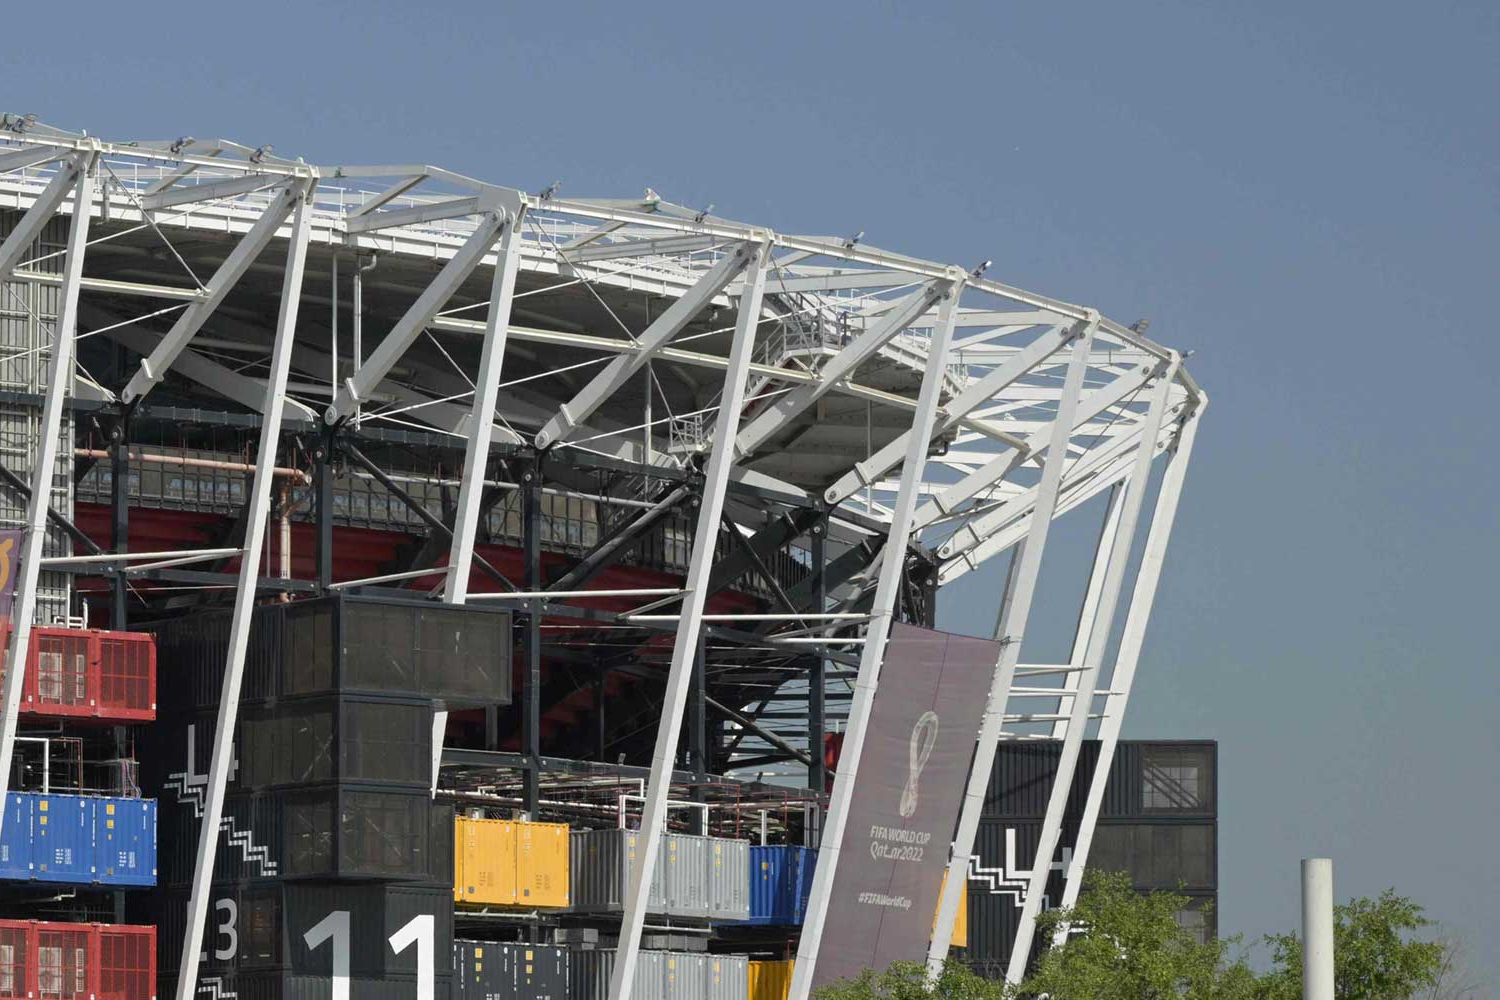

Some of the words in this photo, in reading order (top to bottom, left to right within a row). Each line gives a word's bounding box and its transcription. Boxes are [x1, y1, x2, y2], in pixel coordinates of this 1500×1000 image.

[870, 825, 888, 840] FIFA
[888, 828, 916, 844] WORLD
[916, 831, 931, 844] CUP
